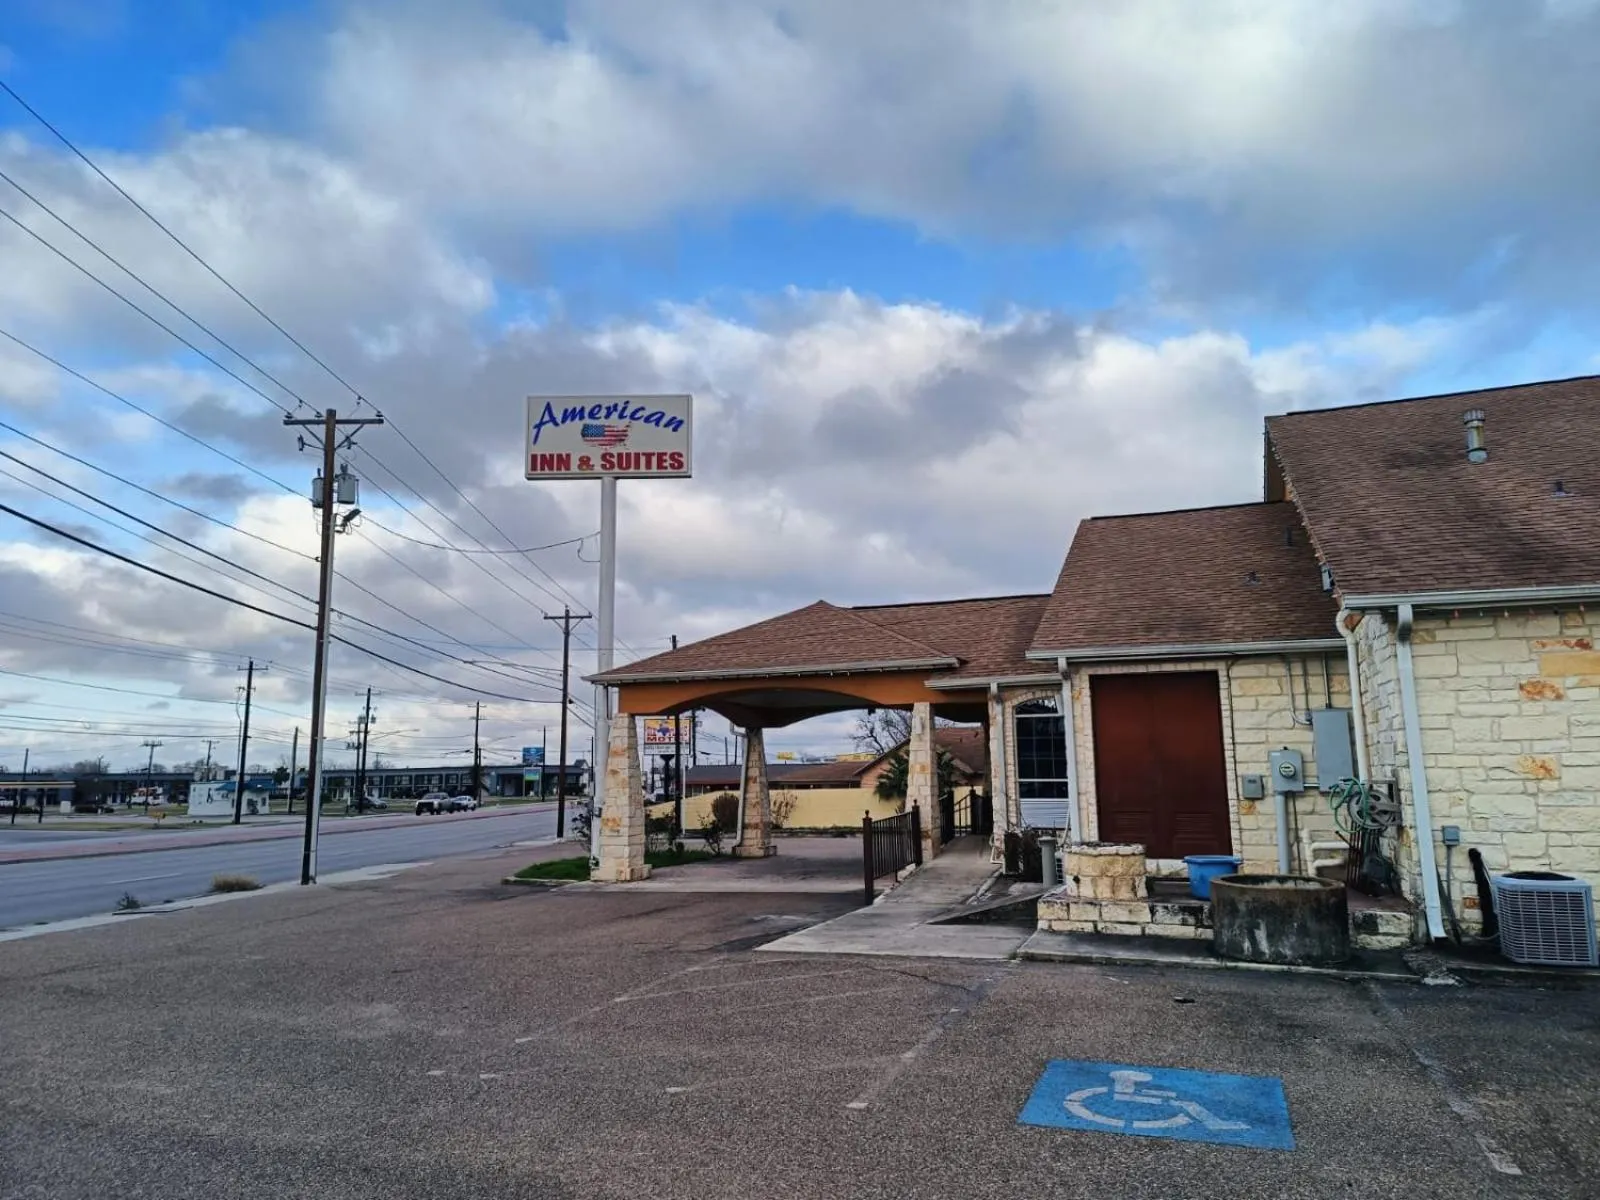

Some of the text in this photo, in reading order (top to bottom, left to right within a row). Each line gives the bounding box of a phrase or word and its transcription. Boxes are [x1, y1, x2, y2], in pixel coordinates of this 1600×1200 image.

[532, 400, 685, 445] American
[530, 451, 684, 472] INN & SUITES
